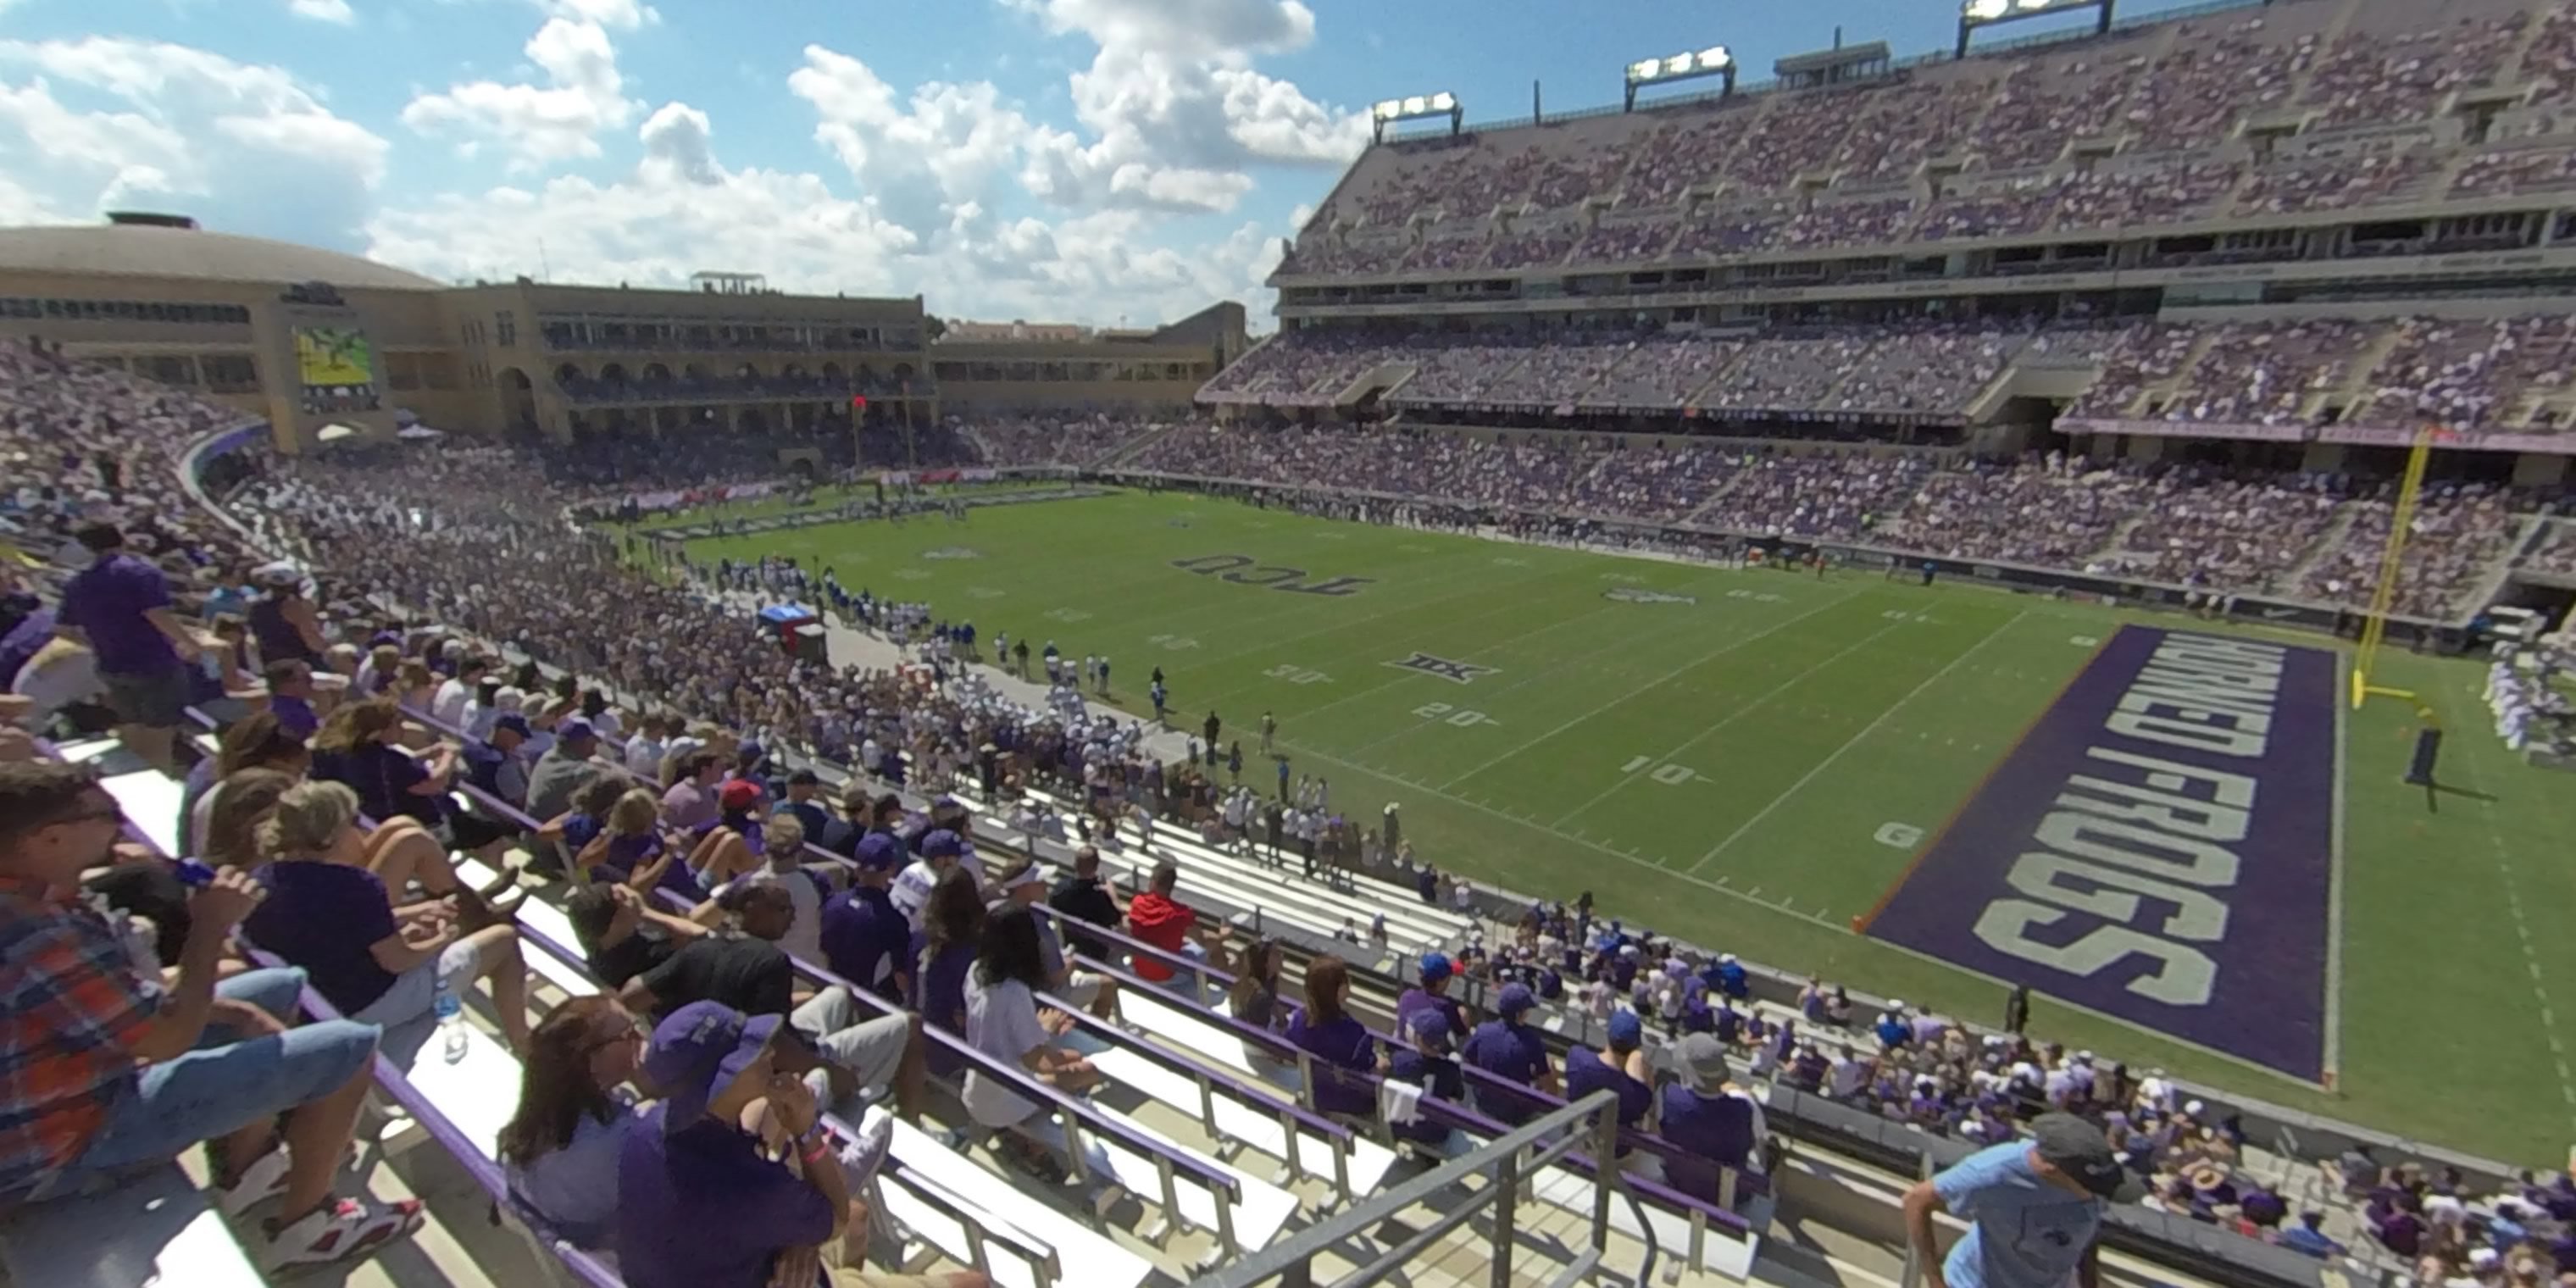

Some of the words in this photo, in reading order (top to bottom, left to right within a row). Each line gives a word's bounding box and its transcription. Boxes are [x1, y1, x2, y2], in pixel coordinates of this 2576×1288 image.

[1169, 554, 1379, 597] TCU
[1411, 702, 1485, 726] 20
[2104, 631, 2287, 758] HORNED
[1621, 755, 1696, 785] 10
[1973, 747, 2258, 1007] FROGS
